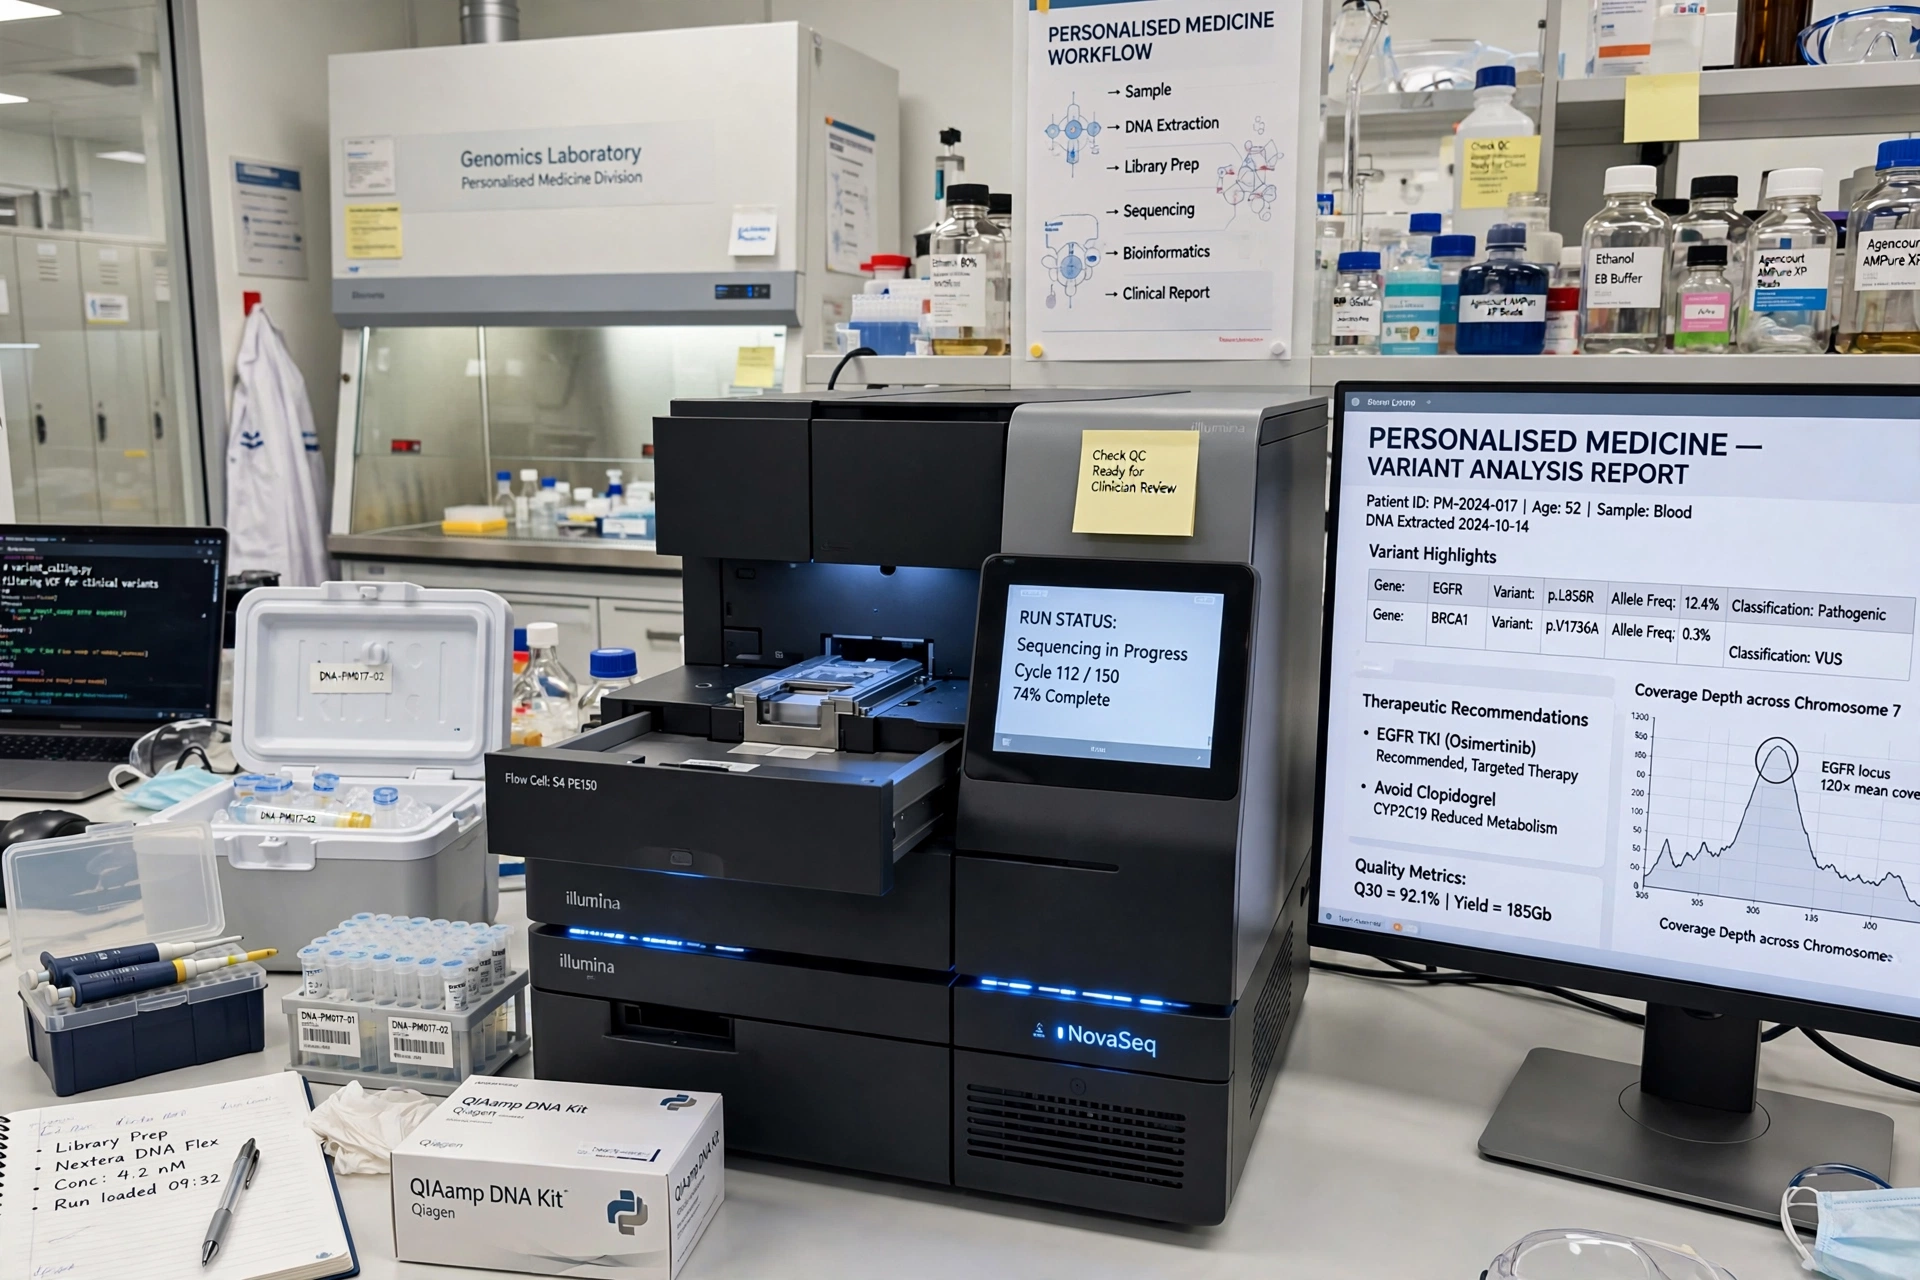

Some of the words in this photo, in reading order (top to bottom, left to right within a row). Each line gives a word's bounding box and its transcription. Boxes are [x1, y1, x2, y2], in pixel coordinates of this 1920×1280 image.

[1049, 19, 1180, 42] PERSONALISED
[1186, 11, 1274, 33] MEDICINE
[1048, 43, 1152, 65] WORKFLOW
[1126, 82, 1171, 100] Sample
[1126, 119, 1153, 133] DNA
[1157, 116, 1219, 131] Extraction
[461, 148, 542, 167] Genomics
[548, 145, 641, 165] Laboratory
[1125, 159, 1167, 174] Library
[1171, 158, 1199, 173] Prep
[462, 174, 534, 189] Personalised
[539, 173, 591, 186] Medicine
[595, 170, 642, 184] Division
[1124, 202, 1194, 220] Sequencing
[1124, 245, 1210, 260] Bioinformatics
[1597, 252, 1634, 264] Ethanol
[1863, 255, 1905, 266] AMPure
[1595, 274, 1607, 284] EB
[1611, 273, 1642, 283] Buffer
[1123, 286, 1165, 300] Clinical
[1170, 286, 1209, 302] Report
[1370, 427, 1577, 452] PERSONALISED
[1586, 431, 1727, 456] MEDICINE
[1093, 449, 1126, 460] Check
[1129, 450, 1146, 462] QC
[1093, 465, 1125, 480] Ready
[1129, 465, 1144, 476] for
[1368, 457, 1464, 478] VARIANT
[1470, 459, 1583, 481] ANALYSIS
[1591, 462, 1689, 484] REPORT
[1367, 494, 1409, 508] Patient
[1413, 496, 1429, 508] ID:
[1434, 497, 1518, 511] PM-2024-017
[1532, 501, 1561, 517] Age:
[1566, 501, 1581, 514] 52
[1597, 503, 1649, 520] Sample:
[1654, 504, 1692, 519] Blood
[1366, 514, 1393, 527] DNA
[1398, 515, 1455, 529] Extracted
[1459, 518, 1529, 532] 2024-10-14
[1369, 544, 1419, 559] Variant
[1424, 546, 1496, 566] Highlights
[3, 576, 42, 588] filtering
[45, 577, 60, 586] VCF
[65, 577, 78, 586] for
[83, 578, 118, 587] clinical
[122, 578, 158, 588] variants
[1375, 579, 1405, 591] Gene:
[1434, 582, 1462, 595] EGFR
[1494, 585, 1534, 599] Variant:
[1612, 592, 1643, 606] Allele
[1647, 594, 1675, 610] Freq:
[1686, 597, 1719, 610] 12.4%
[1732, 599, 1813, 616] Classification:
[1819, 604, 1886, 622] Pathogenic
[1020, 610, 1051, 625] RUN
[1056, 612, 1116, 629] STATUS:
[1373, 608, 1403, 621] Gene:
[1432, 612, 1467, 625] BRCA1
[1492, 616, 1532, 630] Variant:
[1546, 620, 1598, 634] p.V1736A
[1612, 623, 1643, 637] Allele
[1647, 625, 1675, 642] Freq:
[1683, 628, 1710, 641] 0.3%
[1017, 637, 1101, 659] Sequencing
[1106, 642, 1118, 657] in
[1125, 644, 1187, 663] Progress
[1729, 646, 1810, 663] Classification:
[1815, 651, 1842, 665] VUS
[1015, 663, 1051, 681] Cycle
[1057, 666, 1079, 680] 112
[1096, 669, 1119, 683] 150
[1014, 687, 1041, 701] 74%
[1046, 689, 1110, 708] Complete
[1635, 683, 1697, 703] Coverage
[1702, 689, 1742, 706] Depth
[1747, 696, 1790, 708] across
[1795, 696, 1888, 716] Chromosome
[1893, 704, 1901, 717] 7
[1363, 694, 1446, 714] Therapeutic
[1452, 701, 1588, 726] Recommendations
[1378, 727, 1413, 743] EGFR
[1418, 731, 1440, 746] TKI
[1445, 733, 1535, 757] (Osimertinib)
[1377, 749, 1467, 772] Recommended,
[1472, 758, 1524, 776] Targeted
[1528, 764, 1578, 784] Therapy
[1822, 761, 1855, 775] EGFR
[1859, 764, 1890, 779] locus
[506, 773, 527, 784] Flow
[530, 775, 550, 786] Cell:
[553, 777, 565, 788] S4
[568, 778, 597, 790] PE150
[1855, 785, 1888, 796] mean
[1375, 781, 1412, 797] Avoid
[1417, 785, 1495, 808] Clopidogrel
[1374, 802, 1427, 820] CYP2C19
[1432, 809, 1483, 826] Reduced
[1487, 815, 1557, 834] Metabolism
[1356, 858, 1405, 880] Quality
[1410, 865, 1466, 885] Metrics:
[566, 891, 620, 909] illumina
[1354, 882, 1382, 898] Q30
[1400, 888, 1439, 906] 92.1%
[1454, 895, 1488, 912] Yield
[1508, 903, 1551, 921] 185Gb
[1660, 917, 1715, 938] Coverage
[1720, 927, 1755, 943] Depth
[1760, 936, 1799, 949] across
[560, 954, 614, 973] illumina
[1069, 1025, 1155, 1057] NovaSeq
[461, 1096, 522, 1112] QIAamp
[525, 1102, 560, 1111] DNA
[566, 1105, 587, 1113] Kit
[56, 1138, 119, 1153] Library
[131, 1131, 167, 1141] Prep
[56, 1156, 124, 1171] Nextera
[136, 1144, 174, 1159] DNA
[186, 1139, 218, 1151] Flex
[55, 1176, 105, 1190] Conc:
[117, 1168, 148, 1180] 4.2
[159, 1161, 185, 1174] nM
[55, 1199, 89, 1210] Run
[102, 1183, 156, 1202] loaded
[169, 1174, 219, 1190] 09:32
[410, 1178, 485, 1205] QIAamp
[490, 1185, 531, 1205] DNA
[538, 1189, 563, 1208] Kit
[412, 1203, 455, 1220] Qiagen
